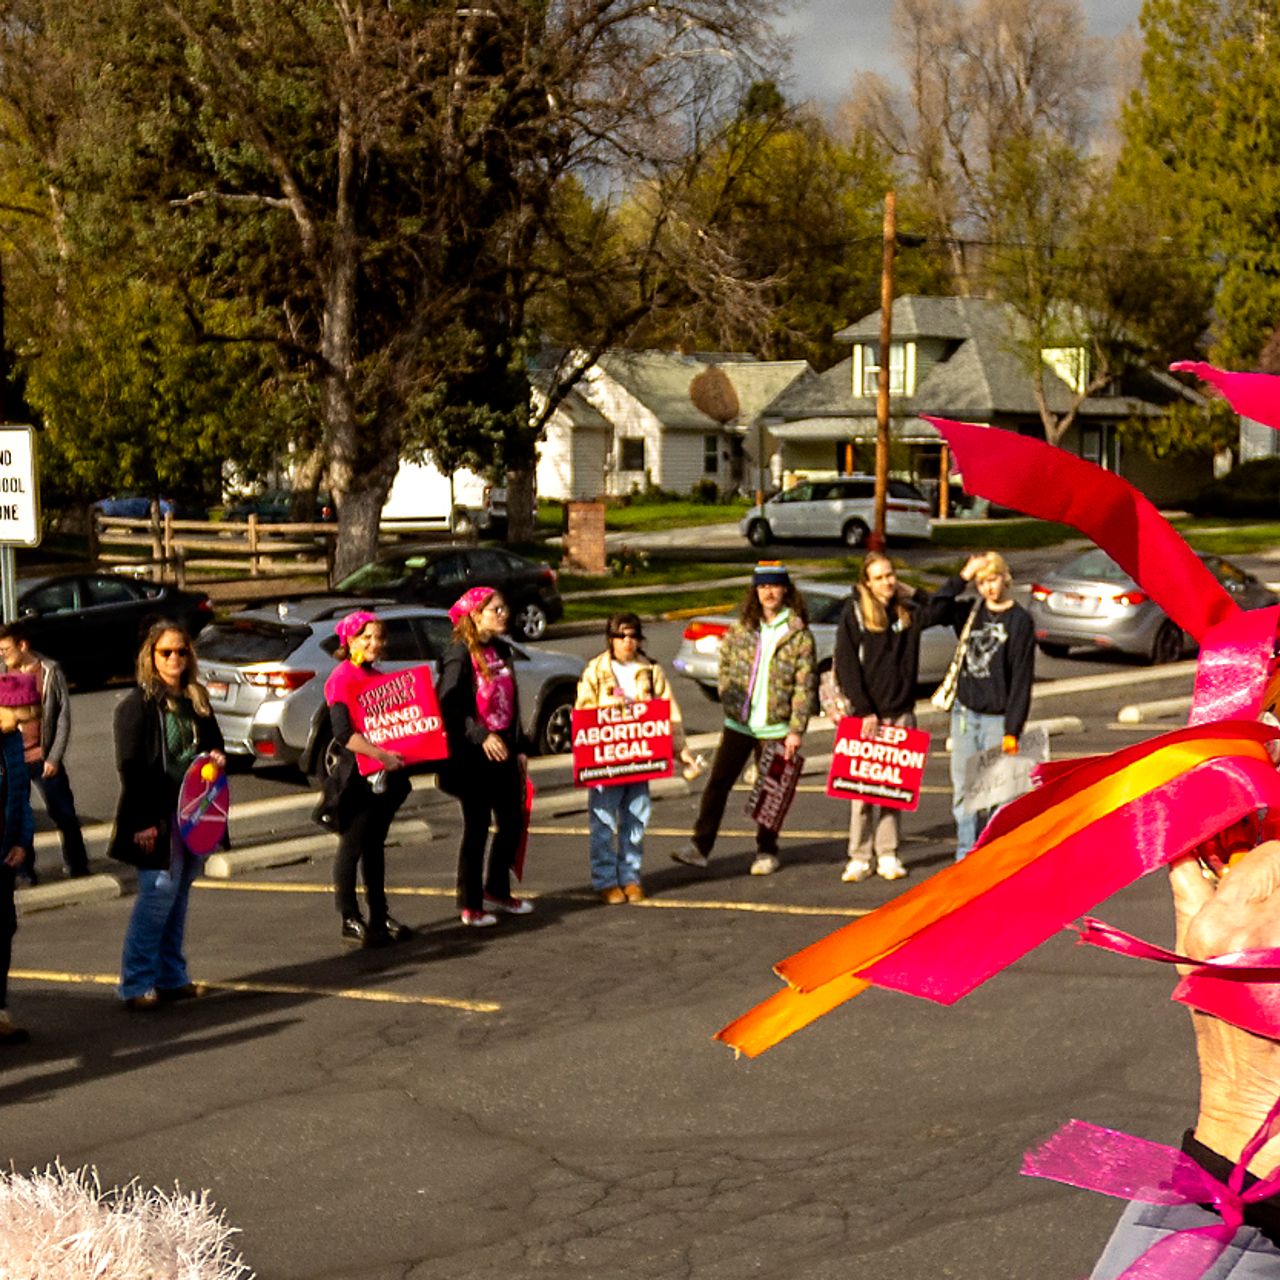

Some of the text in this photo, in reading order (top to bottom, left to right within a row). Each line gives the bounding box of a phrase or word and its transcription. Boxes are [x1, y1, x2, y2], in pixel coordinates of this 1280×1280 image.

[363, 704, 422, 731] PLANNED
[597, 703, 648, 725] KEEP
[363, 716, 441, 745] RENTHOOD
[574, 720, 671, 747] ABORTION
[861, 725, 908, 745] EEP
[594, 740, 654, 763] LEGAL
[835, 737, 924, 769] ABORTION
[849, 757, 903, 785] LEGAL
